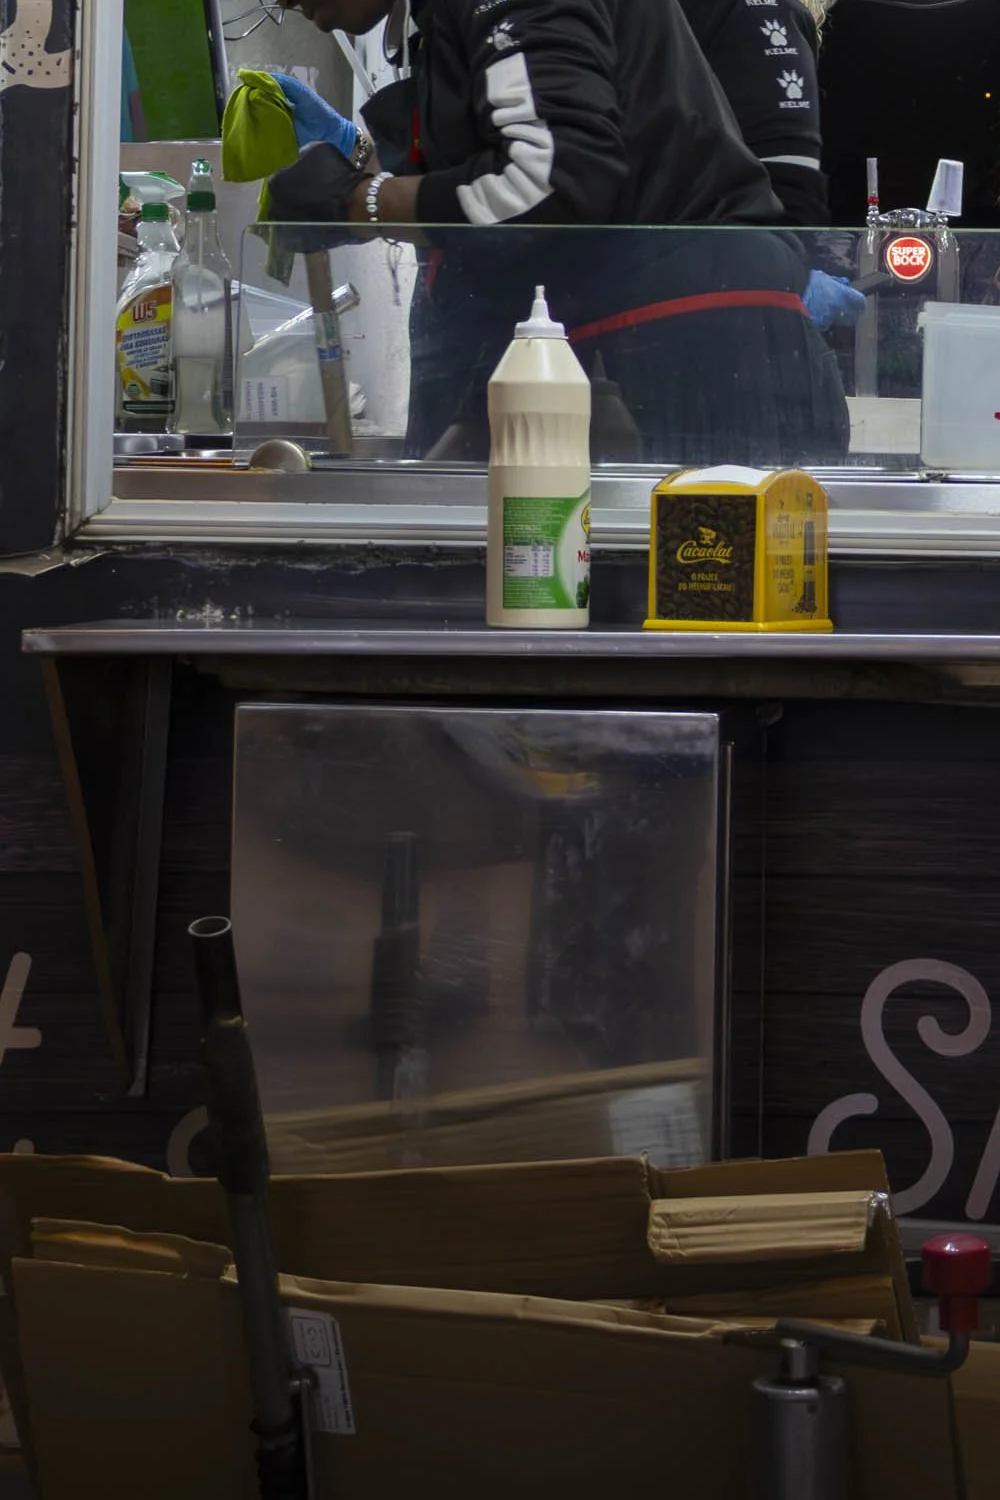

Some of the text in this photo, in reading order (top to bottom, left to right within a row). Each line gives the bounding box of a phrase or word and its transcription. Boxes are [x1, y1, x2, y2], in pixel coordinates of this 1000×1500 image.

[764, 48, 799, 56] KELME
[778, 100, 810, 108] KELME
[892, 246, 926, 256] SUPER
[893, 255, 925, 266] BOCK
[132, 302, 157, 323] W5
[676, 540, 734, 564] Cacaolat
